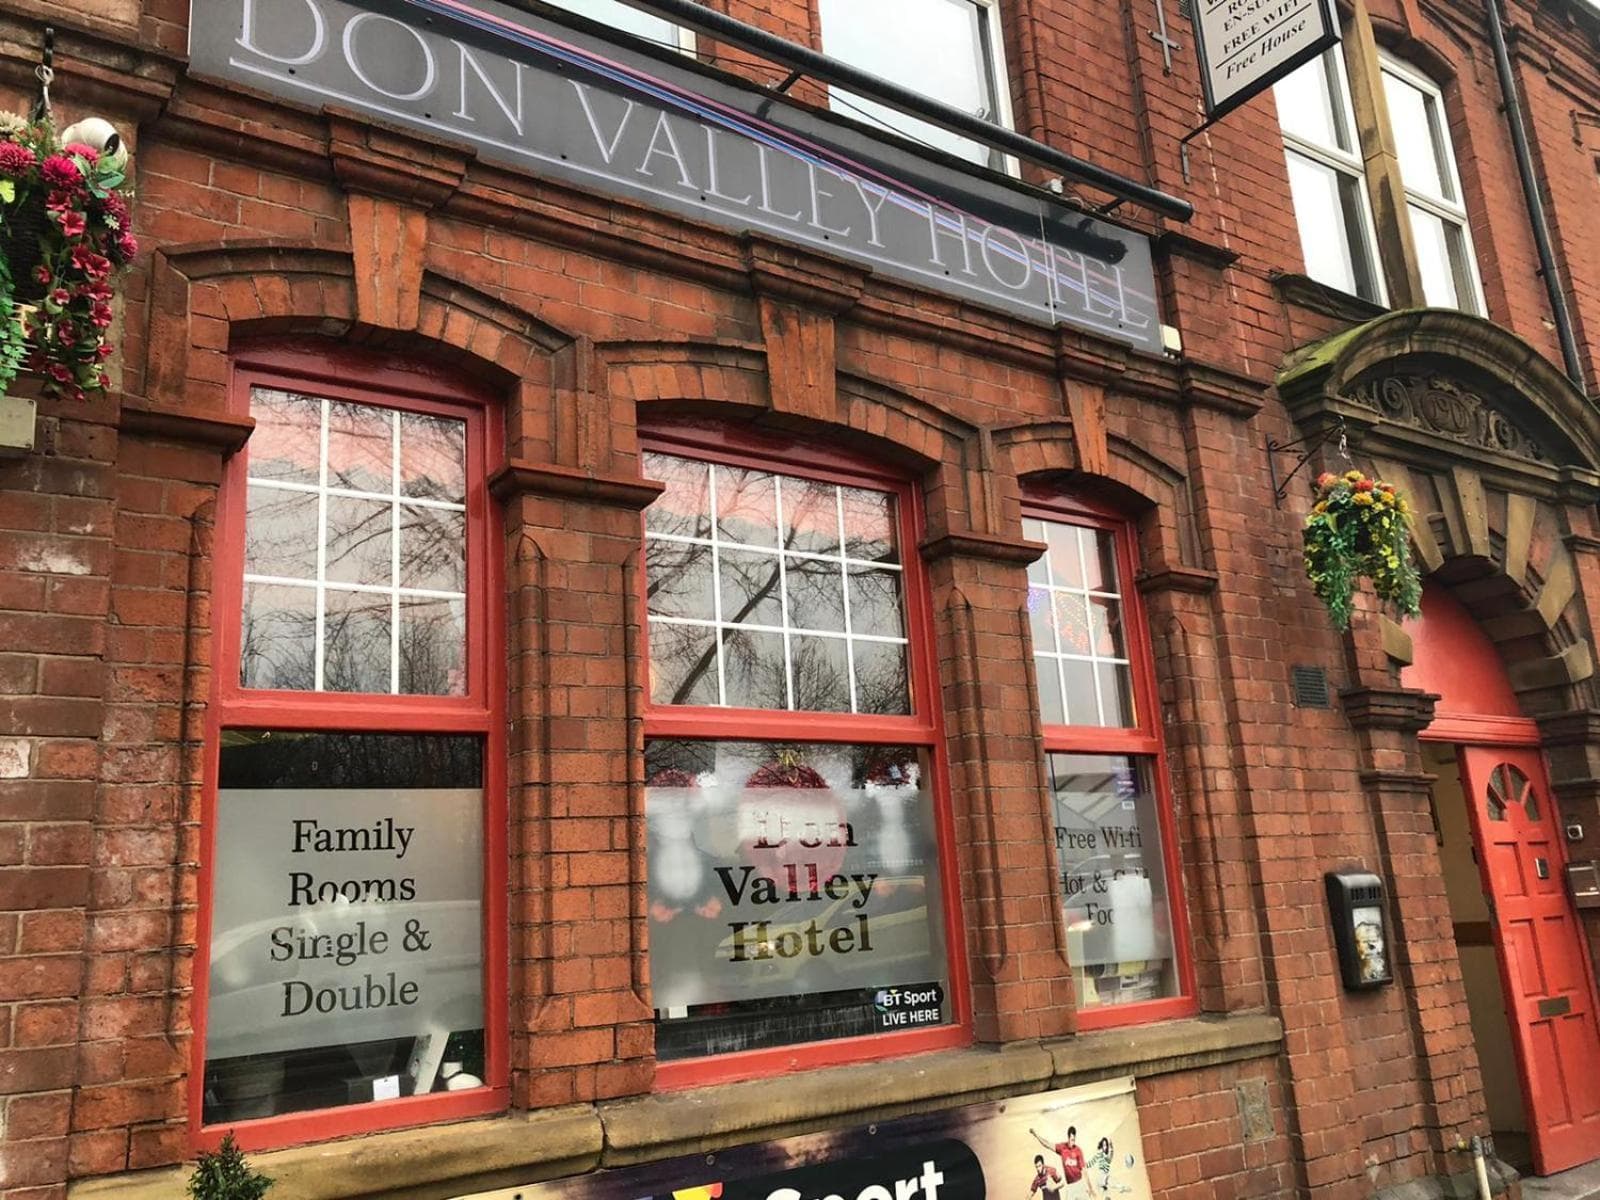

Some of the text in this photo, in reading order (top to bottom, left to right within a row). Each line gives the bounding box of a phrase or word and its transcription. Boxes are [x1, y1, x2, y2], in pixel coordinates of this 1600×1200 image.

[1223, 21, 1261, 54] FREE
[1226, 19, 1306, 79] Free House
[235, 0, 1150, 328] DON VALLEY HOTEL
[291, 818, 415, 859] Family
[1055, 825, 1142, 849] Free Wi-fi
[288, 872, 416, 906] Rooms
[714, 863, 878, 909] Valley
[1092, 870, 1108, 893] &
[270, 918, 432, 966] Single &
[727, 914, 873, 962] Hotel
[280, 972, 419, 1017] Double
[883, 988, 937, 1007] BT Sport
[882, 1008, 939, 1026] LIVE HERE
